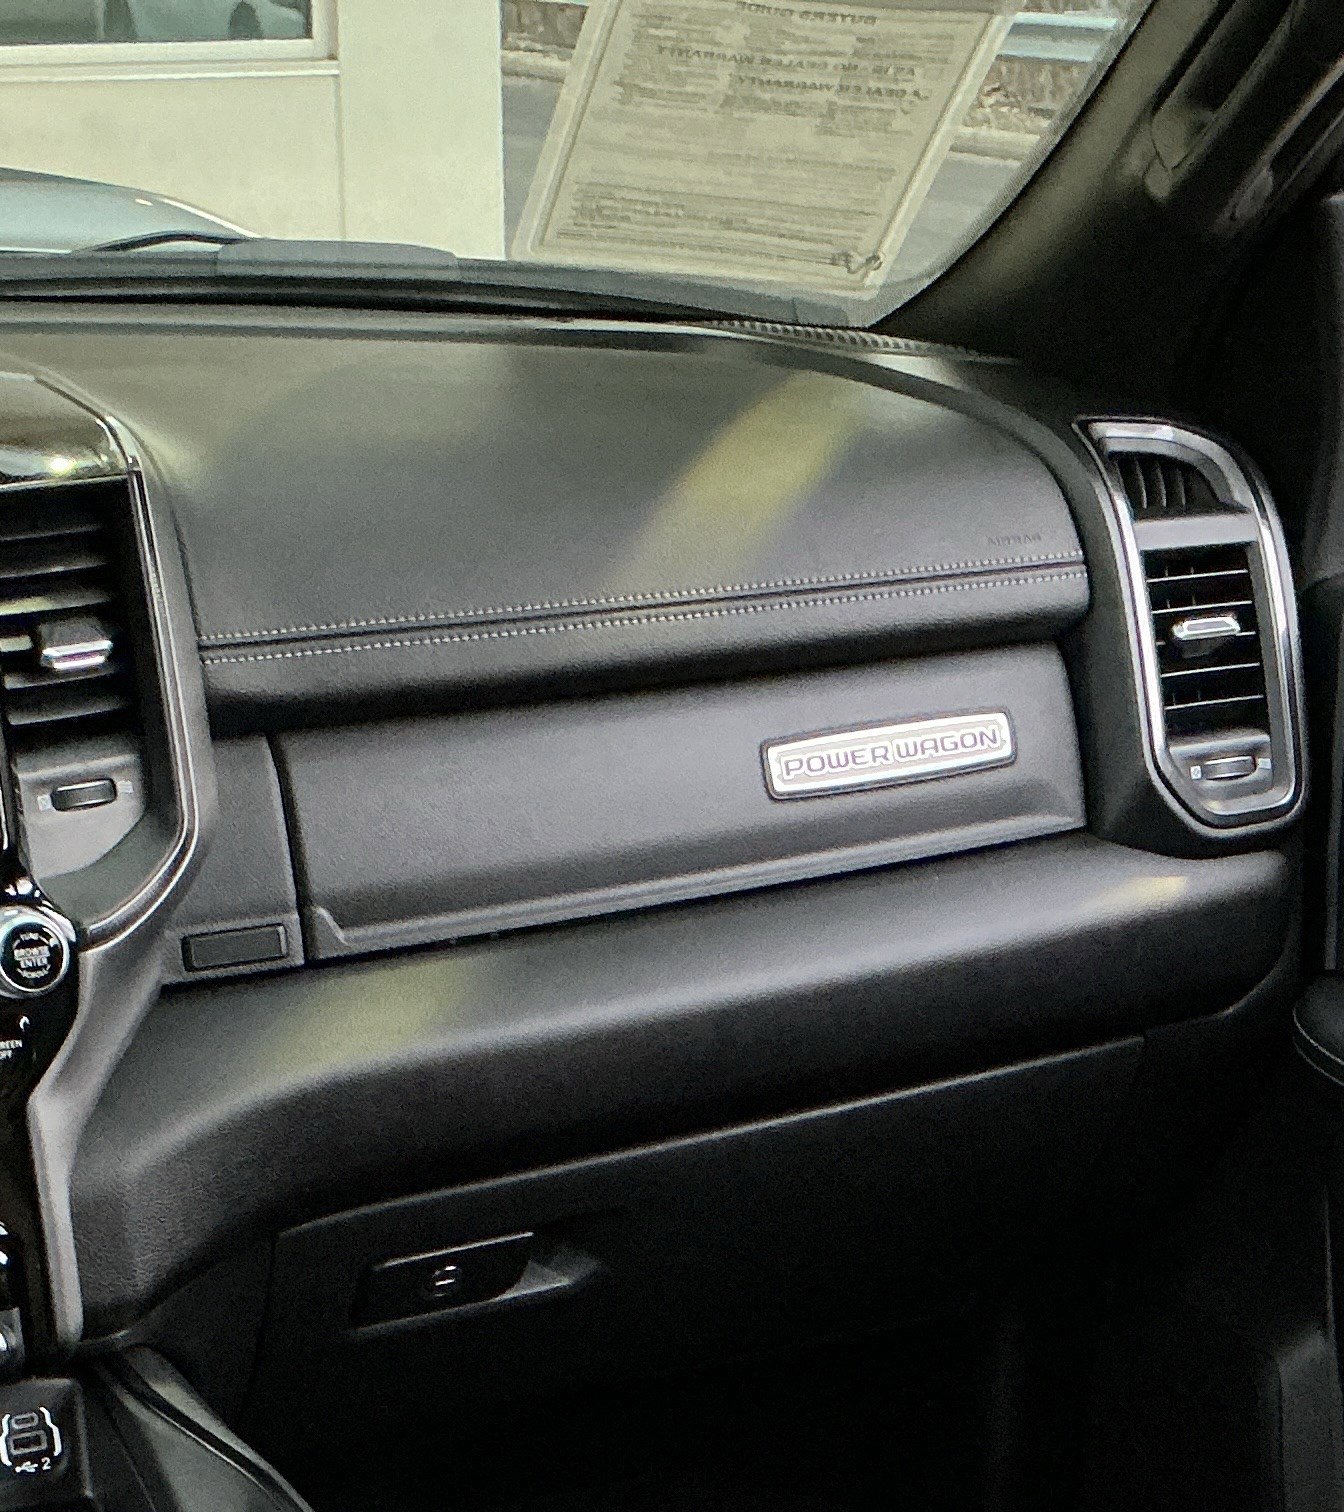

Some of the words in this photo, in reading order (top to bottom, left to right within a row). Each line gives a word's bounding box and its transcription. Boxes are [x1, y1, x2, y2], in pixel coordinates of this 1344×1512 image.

[783, 744, 890, 777] POWER
[895, 728, 998, 759] WAGON
[41, 1456, 52, 1471] 2
